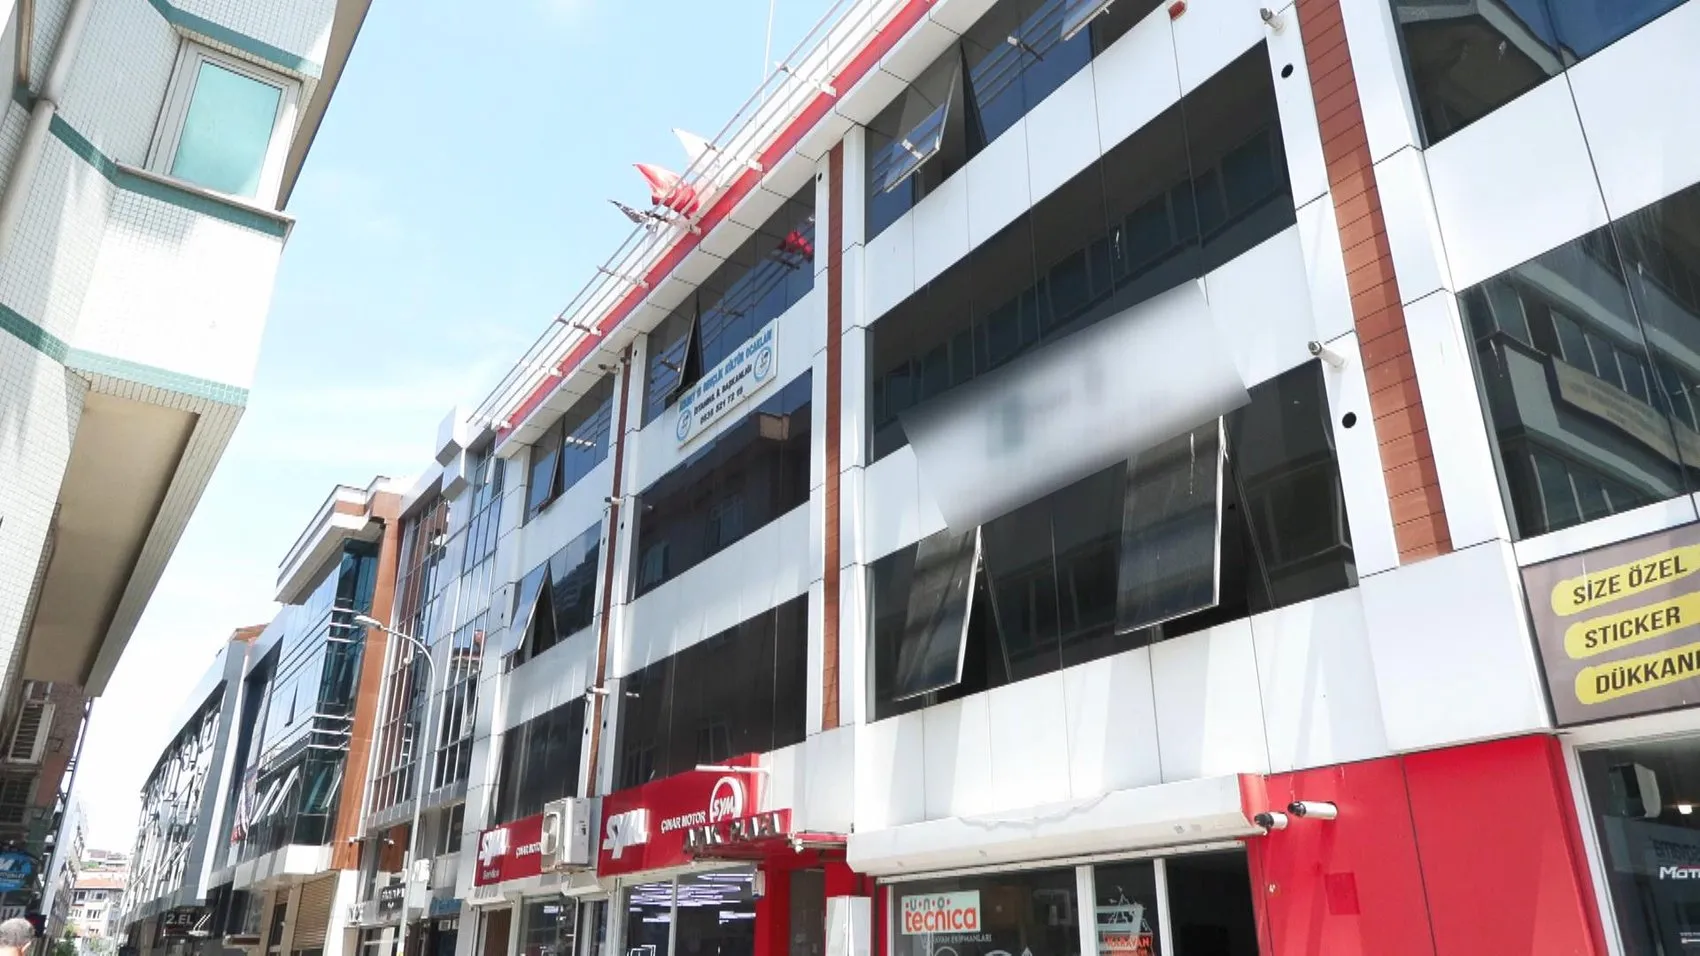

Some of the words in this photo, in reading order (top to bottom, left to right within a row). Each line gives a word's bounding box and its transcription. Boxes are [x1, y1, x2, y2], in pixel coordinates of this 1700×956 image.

[1573, 574, 1621, 606] SİZE
[1628, 555, 1687, 588] ÖZEL
[1585, 606, 1681, 649] STICKER
[661, 819, 682, 834] ÇINAR
[682, 811, 706, 827] MOTOR
[713, 796, 736, 822] SYM
[602, 807, 651, 859] SYM
[166, 912, 194, 925] 2.EL
[904, 905, 977, 933] tecnica
